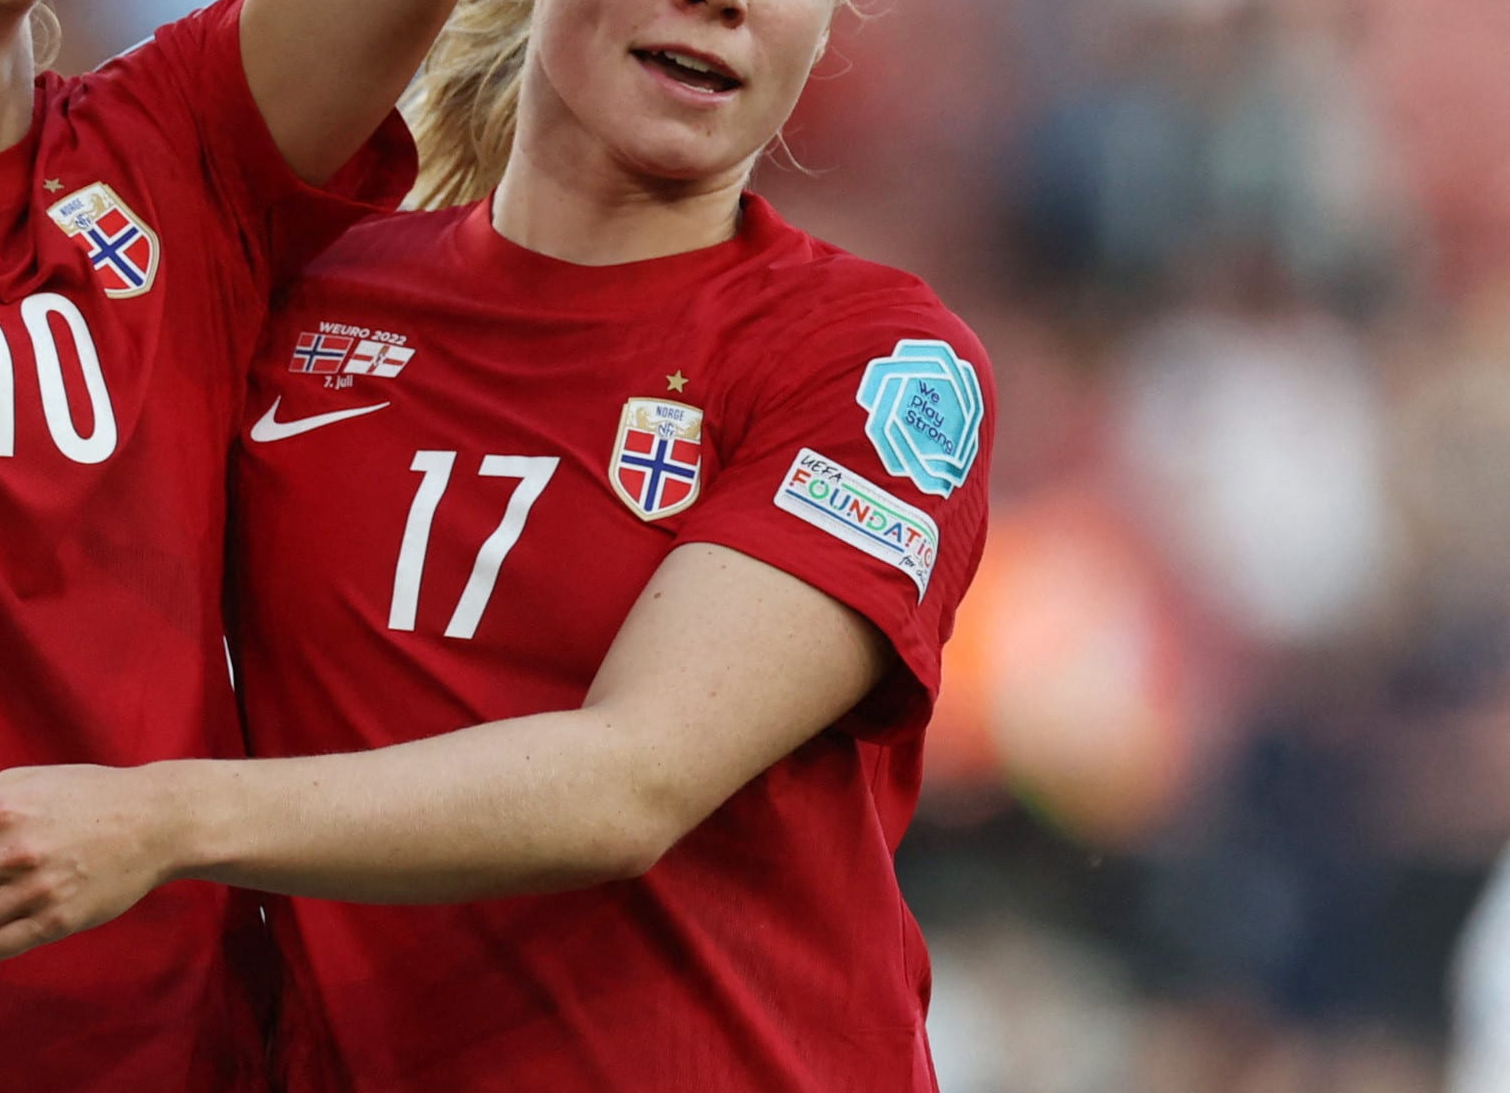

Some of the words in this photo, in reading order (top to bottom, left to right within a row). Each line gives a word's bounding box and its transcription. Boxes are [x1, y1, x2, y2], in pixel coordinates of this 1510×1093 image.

[318, 321, 370, 339] WEURO
[371, 330, 408, 346] 2022
[919, 380, 940, 403] We
[655, 405, 685, 422] NORGE
[910, 394, 945, 428] Play
[905, 409, 954, 455] Strong
[800, 455, 843, 484] UEFA
[388, 450, 561, 640] 17
[898, 554, 916, 567] for
